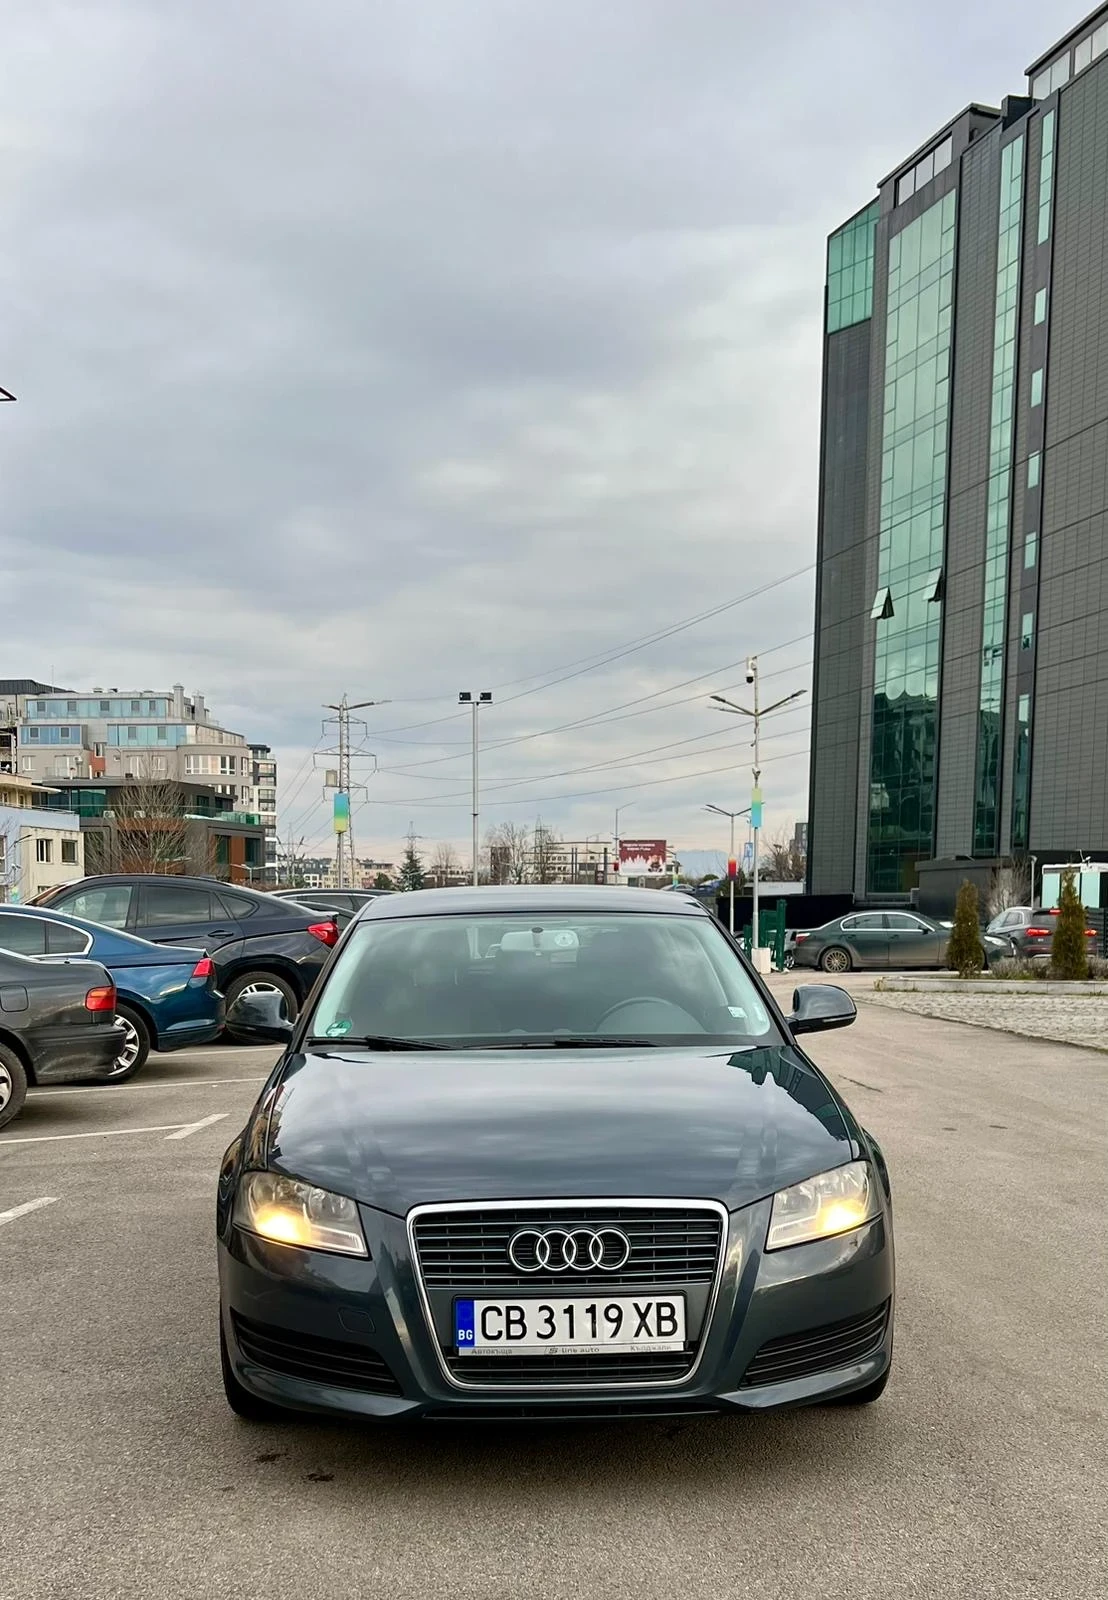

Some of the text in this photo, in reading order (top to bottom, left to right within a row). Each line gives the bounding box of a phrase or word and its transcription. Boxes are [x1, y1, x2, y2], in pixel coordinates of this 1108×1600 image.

[481, 1302, 679, 1341] CB 3119 XB
[458, 1329, 473, 1340] BG
